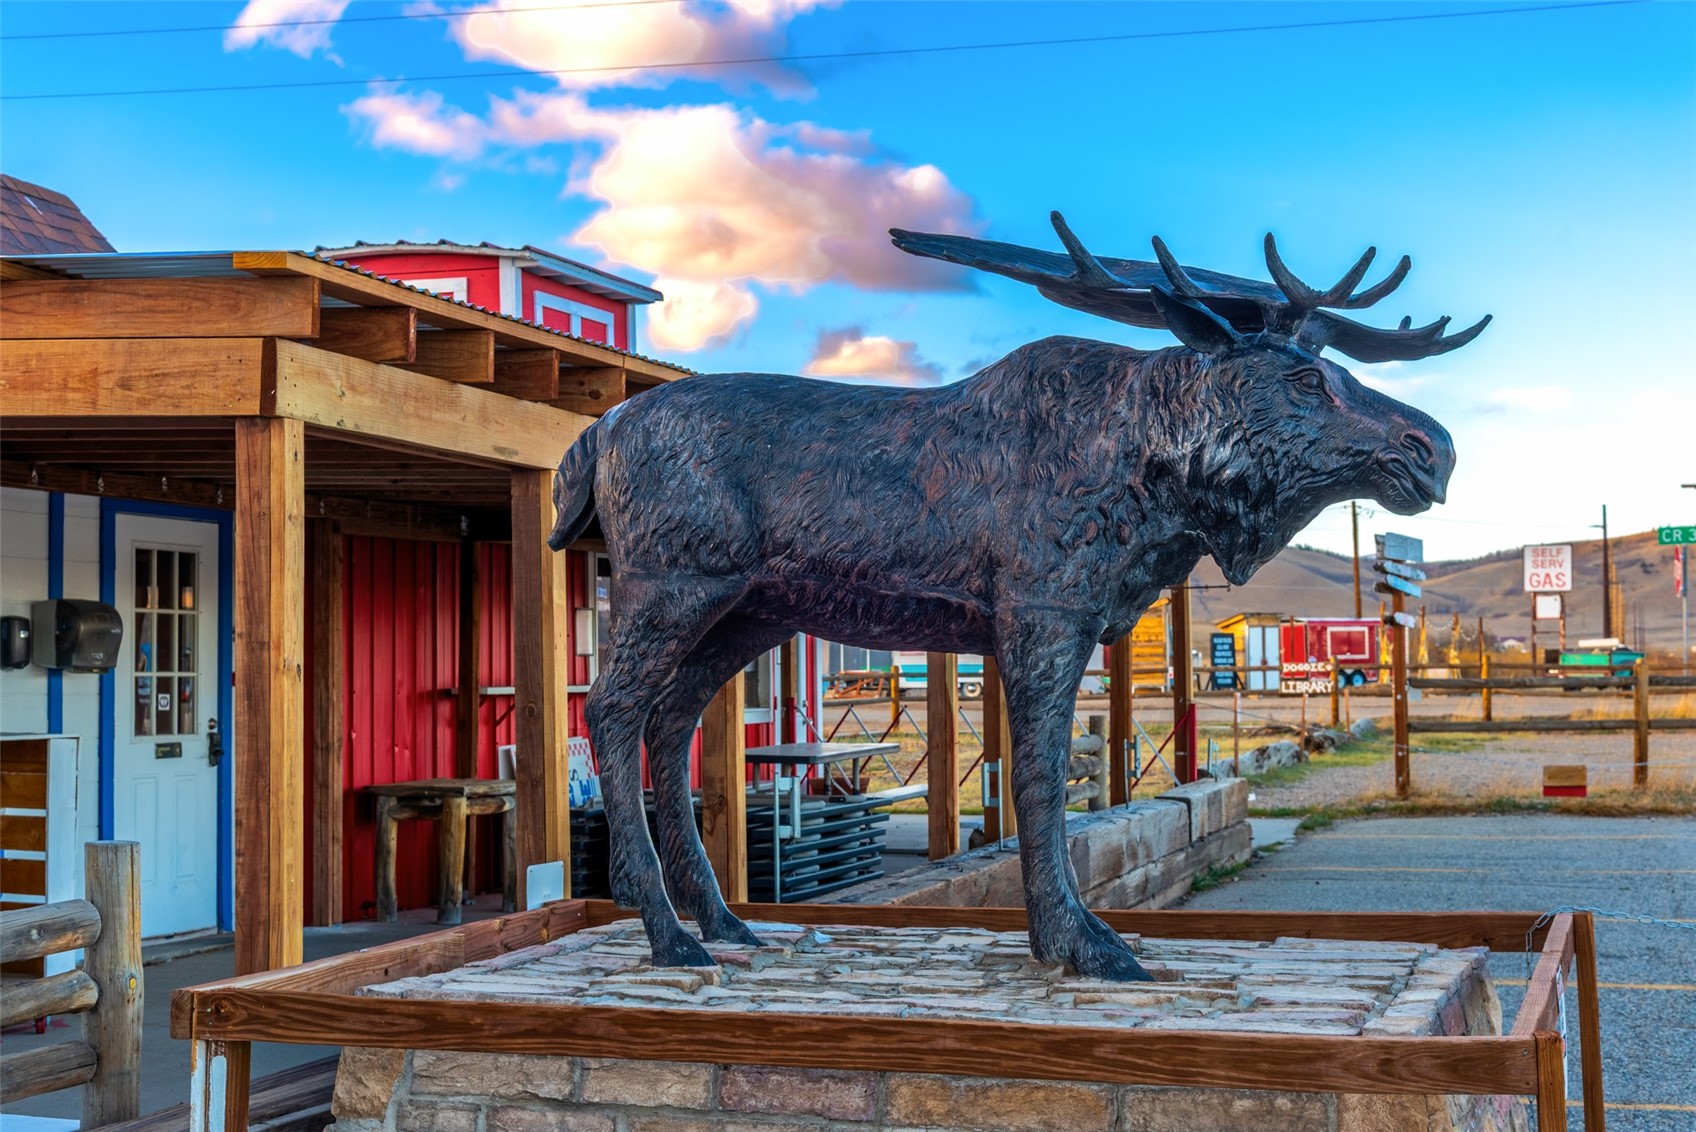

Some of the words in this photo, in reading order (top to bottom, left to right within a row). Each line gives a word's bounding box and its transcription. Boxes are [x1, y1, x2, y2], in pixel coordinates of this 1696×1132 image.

[1662, 529, 1682, 542] CR
[1531, 547, 1564, 558] SELF
[1531, 559, 1565, 569] SERV
[1529, 572, 1567, 588] GAS
[1282, 663, 1326, 672] DOGGIE
[1281, 681, 1334, 693] LIBRARY
